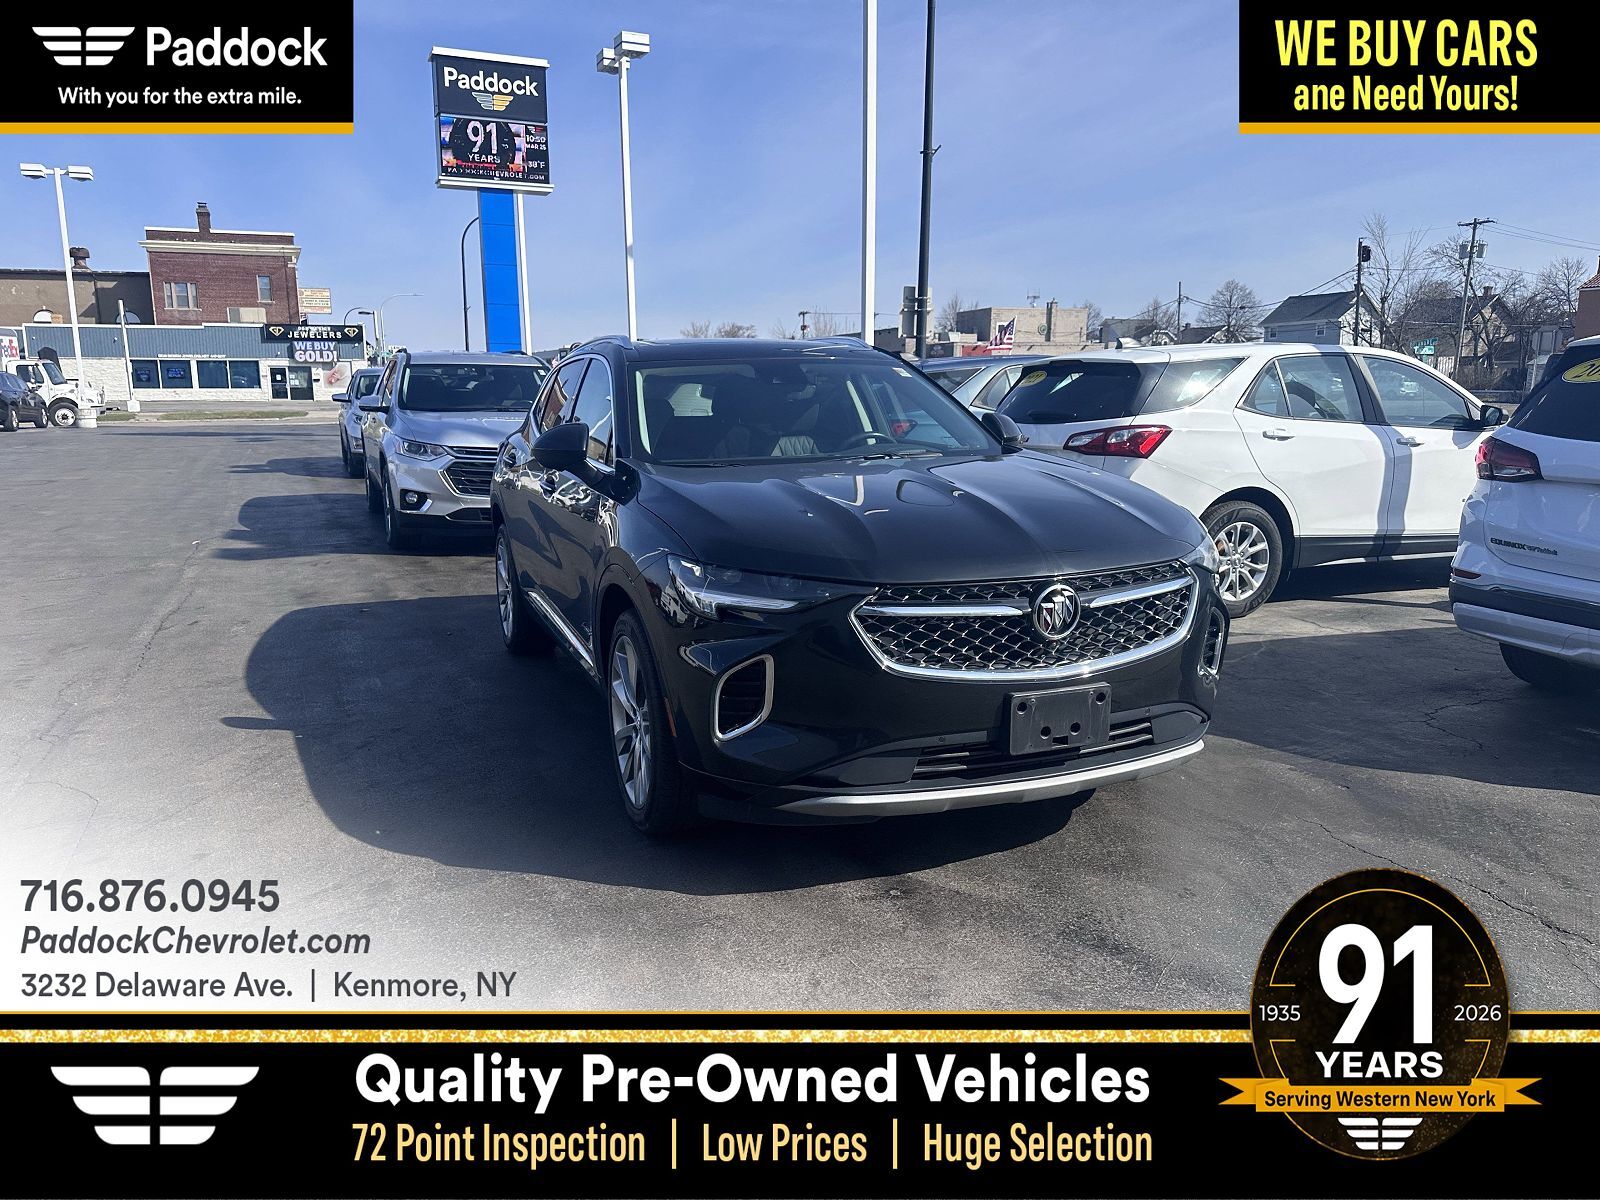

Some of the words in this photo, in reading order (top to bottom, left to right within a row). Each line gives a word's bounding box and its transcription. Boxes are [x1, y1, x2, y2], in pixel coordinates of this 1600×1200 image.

[443, 66, 539, 96] Paddock
[466, 120, 498, 154] 91
[468, 152, 501, 163] YEARS
[287, 331, 342, 339] JEWELERS
[294, 341, 313, 351] WE
[314, 341, 336, 351] BUY
[294, 350, 338, 362] GOLD!
[1490, 537, 1526, 551] EQUINOX
